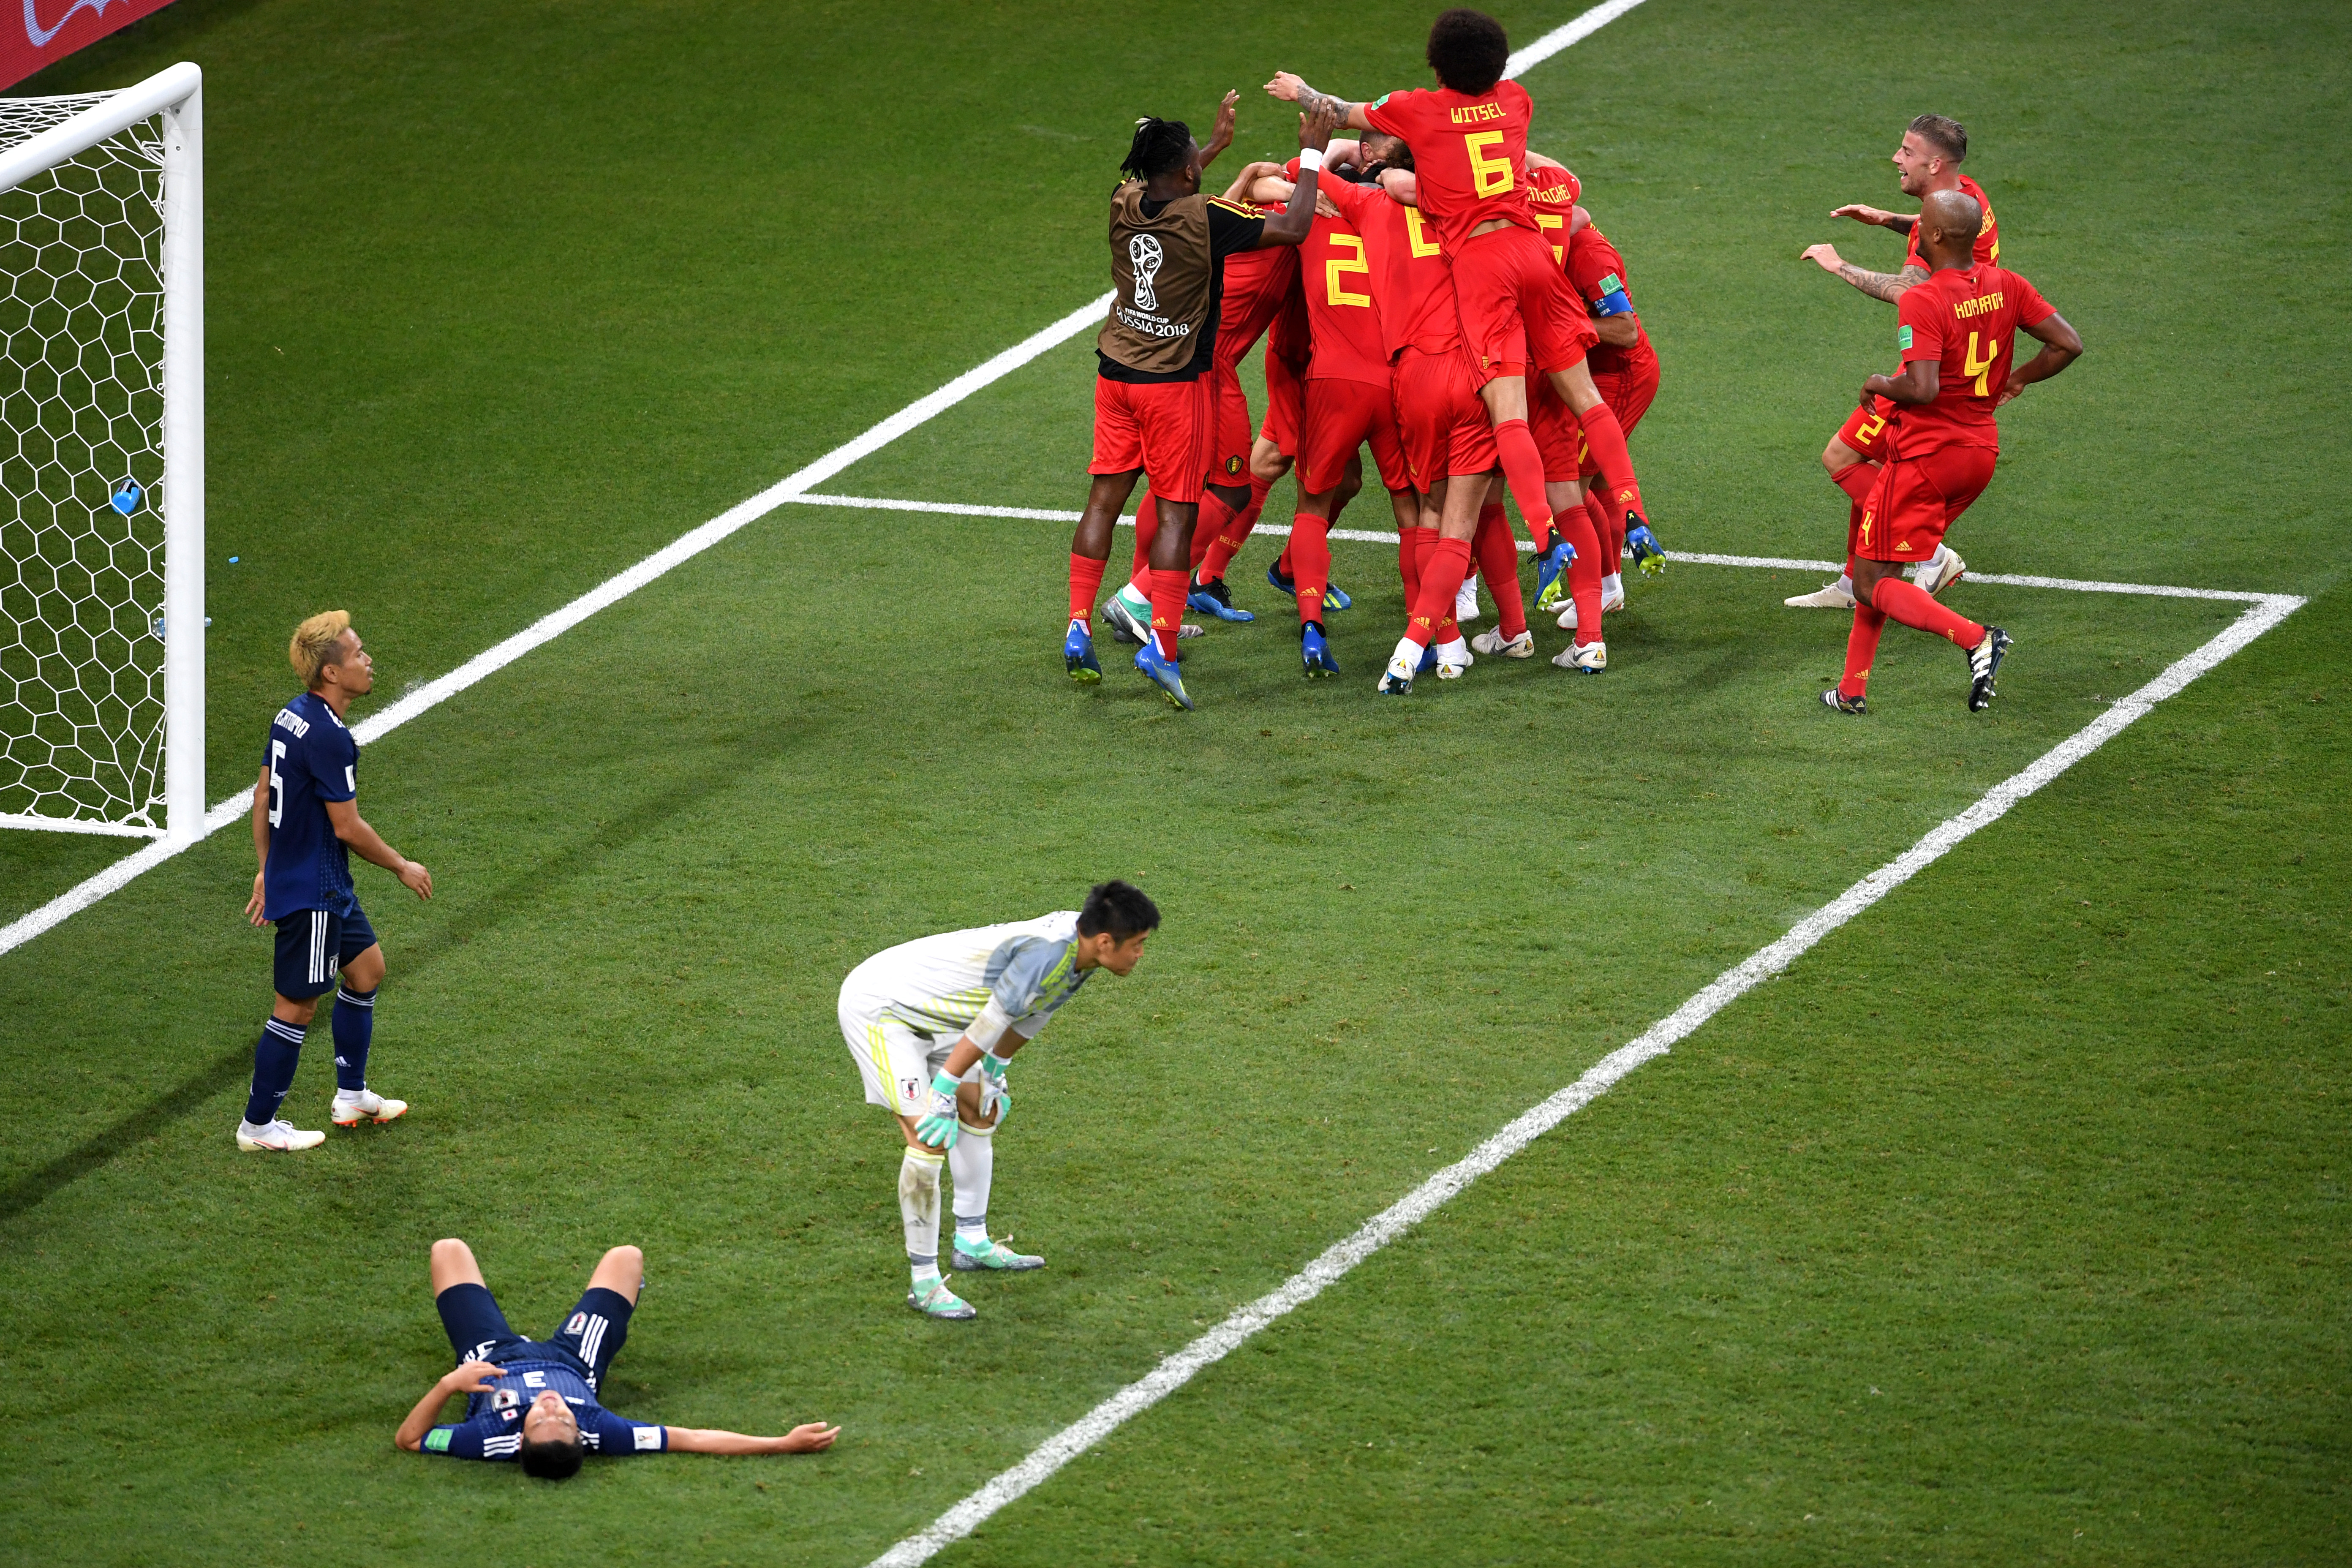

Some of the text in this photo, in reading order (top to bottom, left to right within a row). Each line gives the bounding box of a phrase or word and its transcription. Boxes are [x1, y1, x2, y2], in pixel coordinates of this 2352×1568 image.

[1451, 102, 1507, 123] WITSEL
[1465, 130, 1514, 199] 6
[1326, 233, 1370, 308] 2
[1125, 308, 1136, 316] FIFA
[1136, 311, 1156, 321] WORLD
[1954, 291, 2004, 319] KOMPANY
[1116, 306, 1189, 337] RUSSIA 2018
[1964, 332, 1998, 396] 4
[1855, 414, 1886, 445] 2
[1619, 496, 1636, 505] adidas
[1862, 511, 1872, 546] 4
[1413, 619, 1430, 631] adidas
[269, 739, 286, 829] 5
